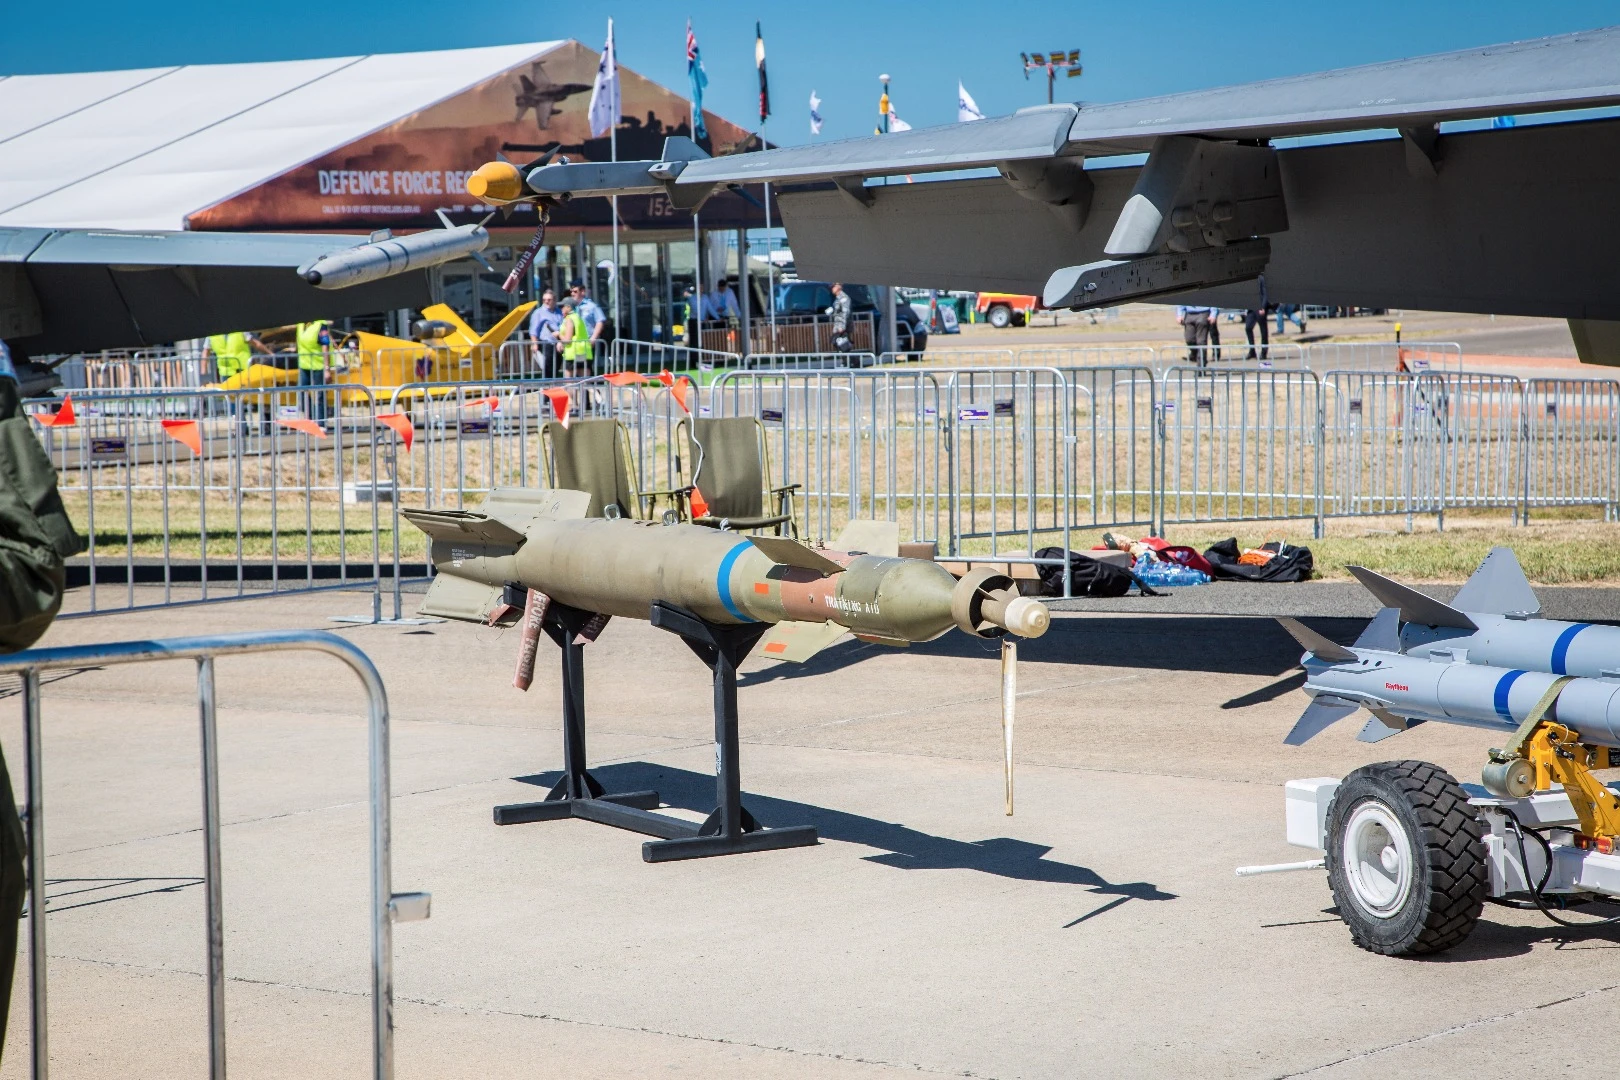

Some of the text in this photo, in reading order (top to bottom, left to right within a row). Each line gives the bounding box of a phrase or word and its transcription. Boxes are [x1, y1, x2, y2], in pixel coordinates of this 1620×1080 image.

[318, 170, 389, 195] DEFENCE
[393, 170, 442, 195] FORCE
[824, 595, 880, 615] TRAINING AID
[1385, 682, 1408, 691] Raytheon
